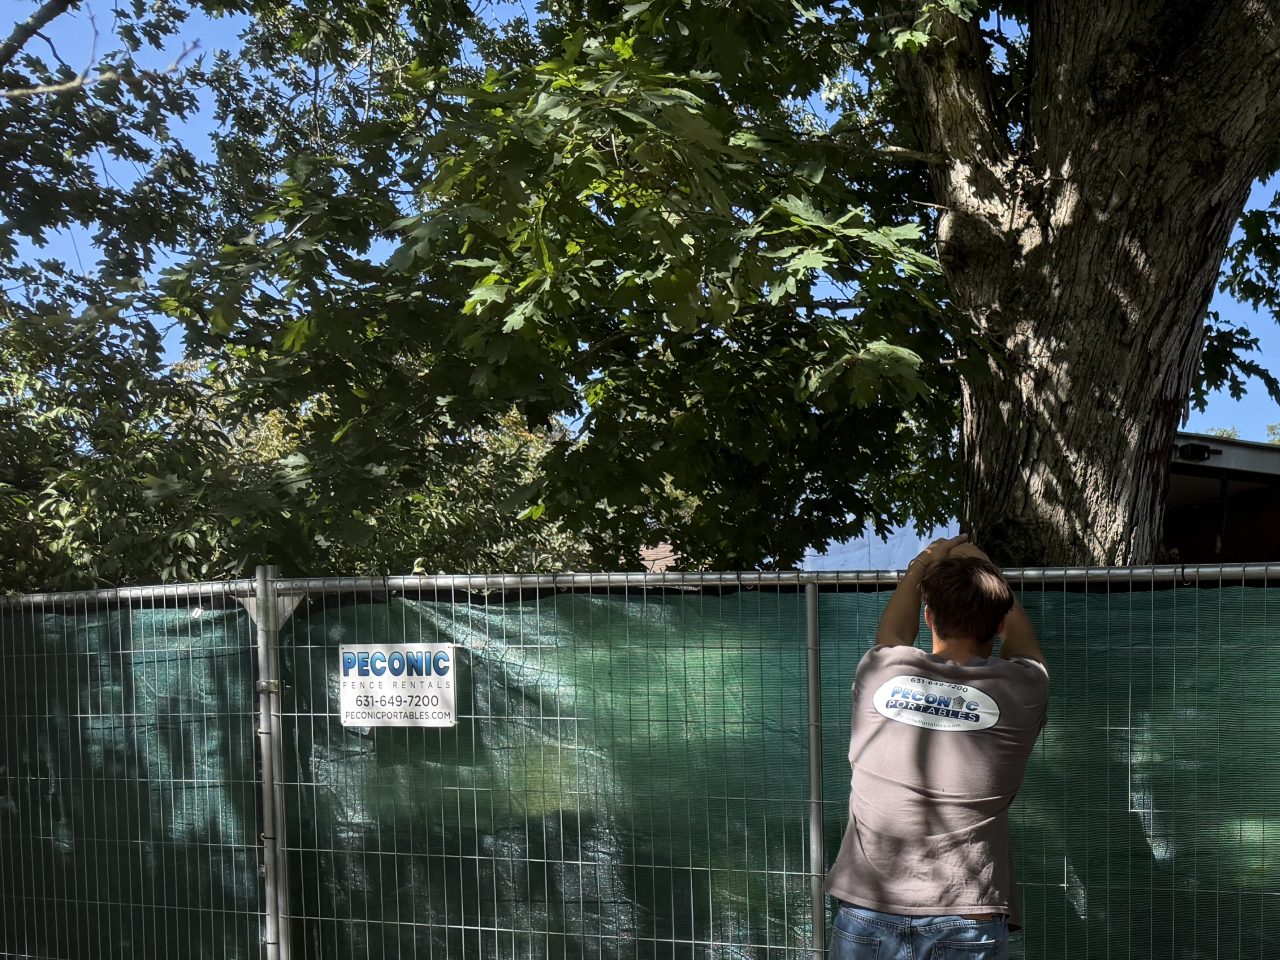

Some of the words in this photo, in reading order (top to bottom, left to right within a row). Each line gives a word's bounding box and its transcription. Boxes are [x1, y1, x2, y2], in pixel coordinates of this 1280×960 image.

[342, 651, 450, 677] PECONIC
[343, 681, 383, 690] FENCE
[393, 681, 451, 689] RENTALS
[356, 695, 439, 707] 631-649-7200
[345, 711, 451, 720] PECONICPORTABLES.COM
[887, 700, 977, 722] PORTABLES
